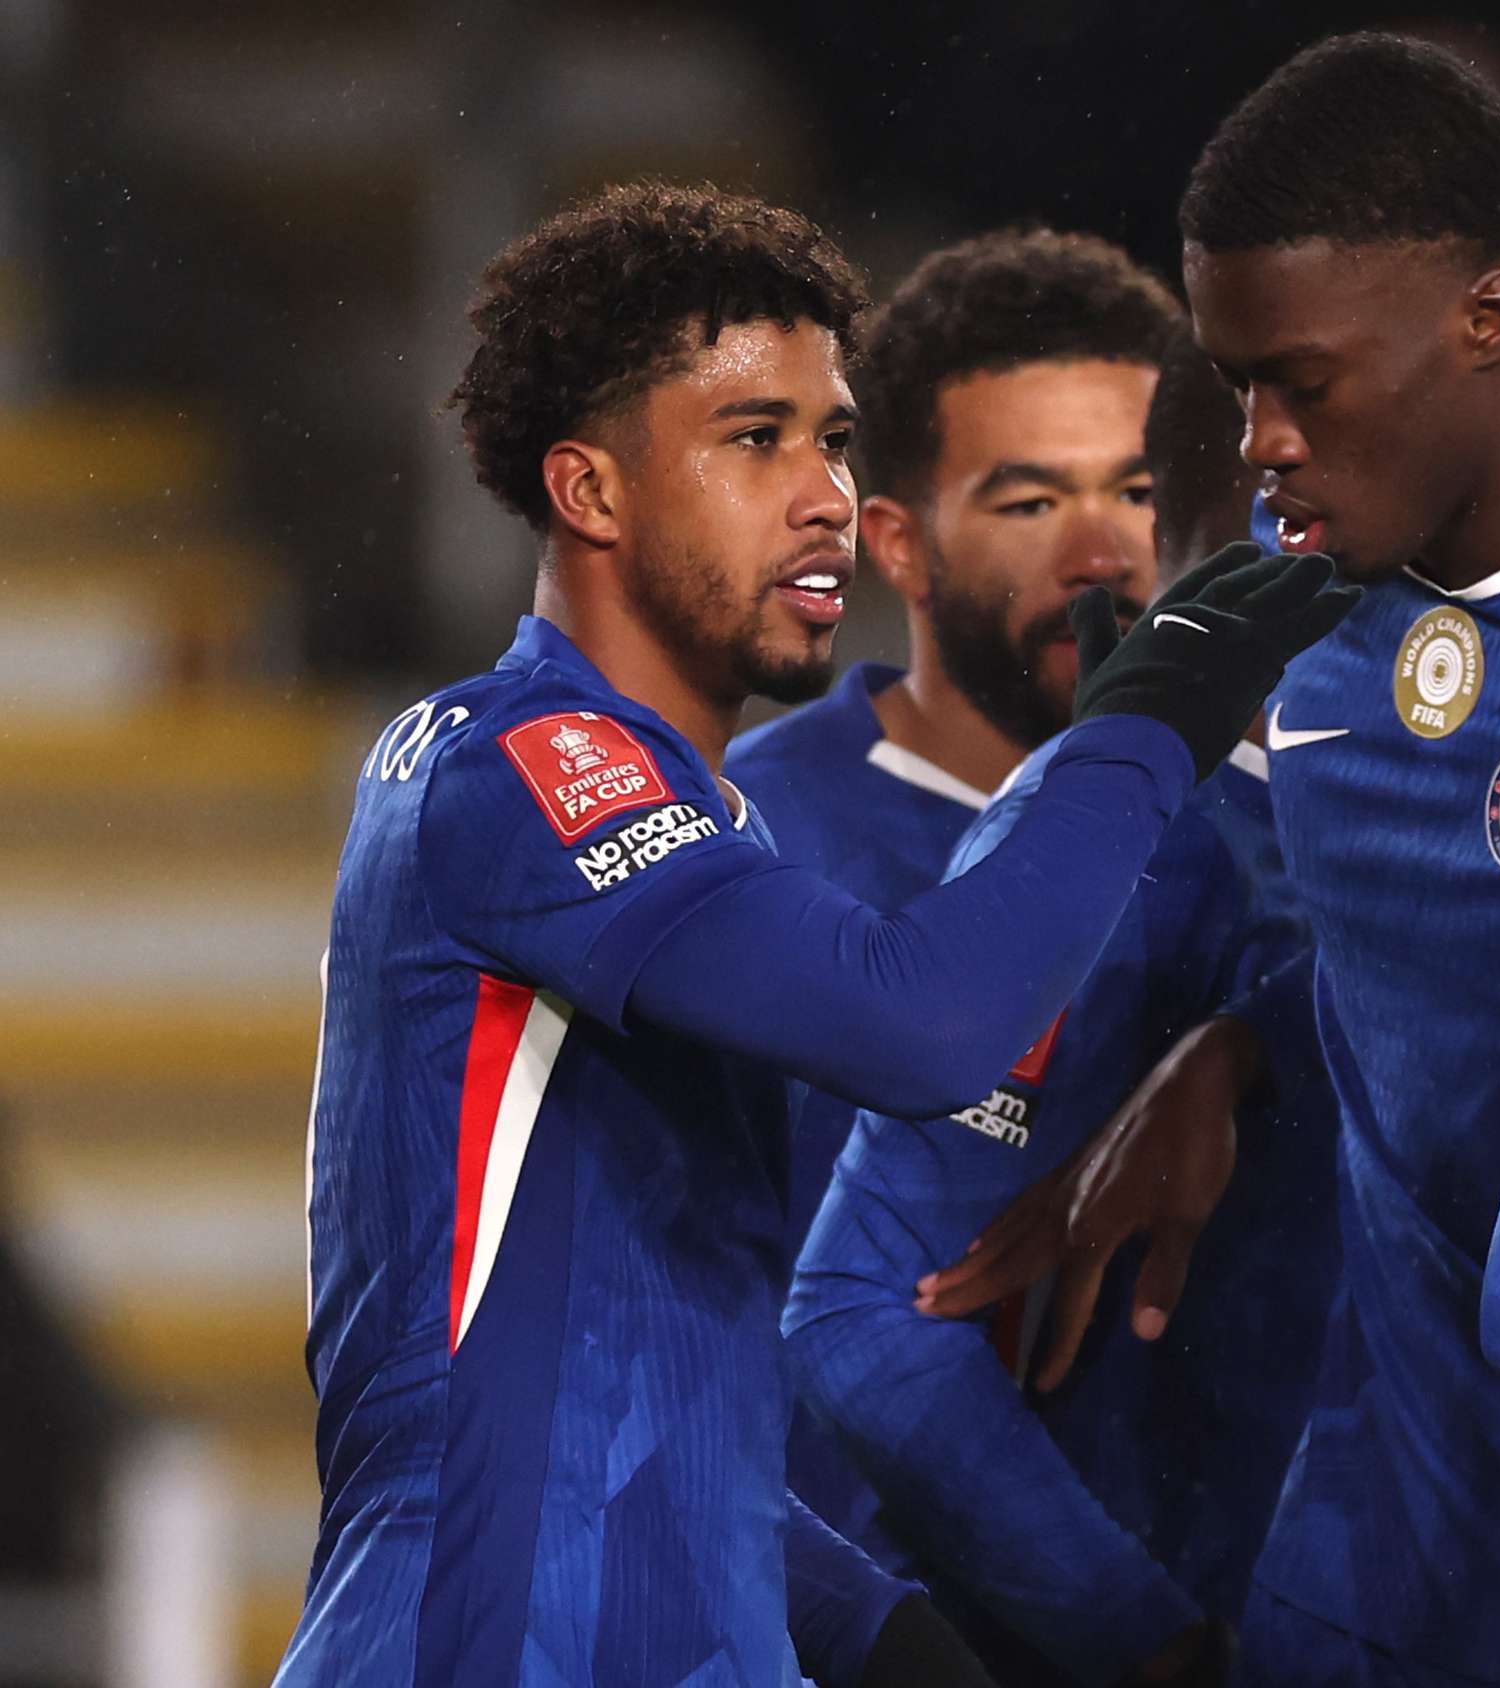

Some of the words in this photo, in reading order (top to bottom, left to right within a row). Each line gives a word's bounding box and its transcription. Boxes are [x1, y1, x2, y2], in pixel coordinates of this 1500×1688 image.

[1401, 622, 1435, 679] WORLD
[1437, 616, 1477, 696] CHAMPIONS
[1410, 703, 1448, 730] FIFA
[554, 763, 640, 802] Emirates
[563, 794, 598, 820] FA
[596, 775, 647, 800] CUP
[575, 841, 622, 881] No
[618, 804, 697, 850] room
[591, 858, 630, 891] for
[631, 816, 719, 870] racism
